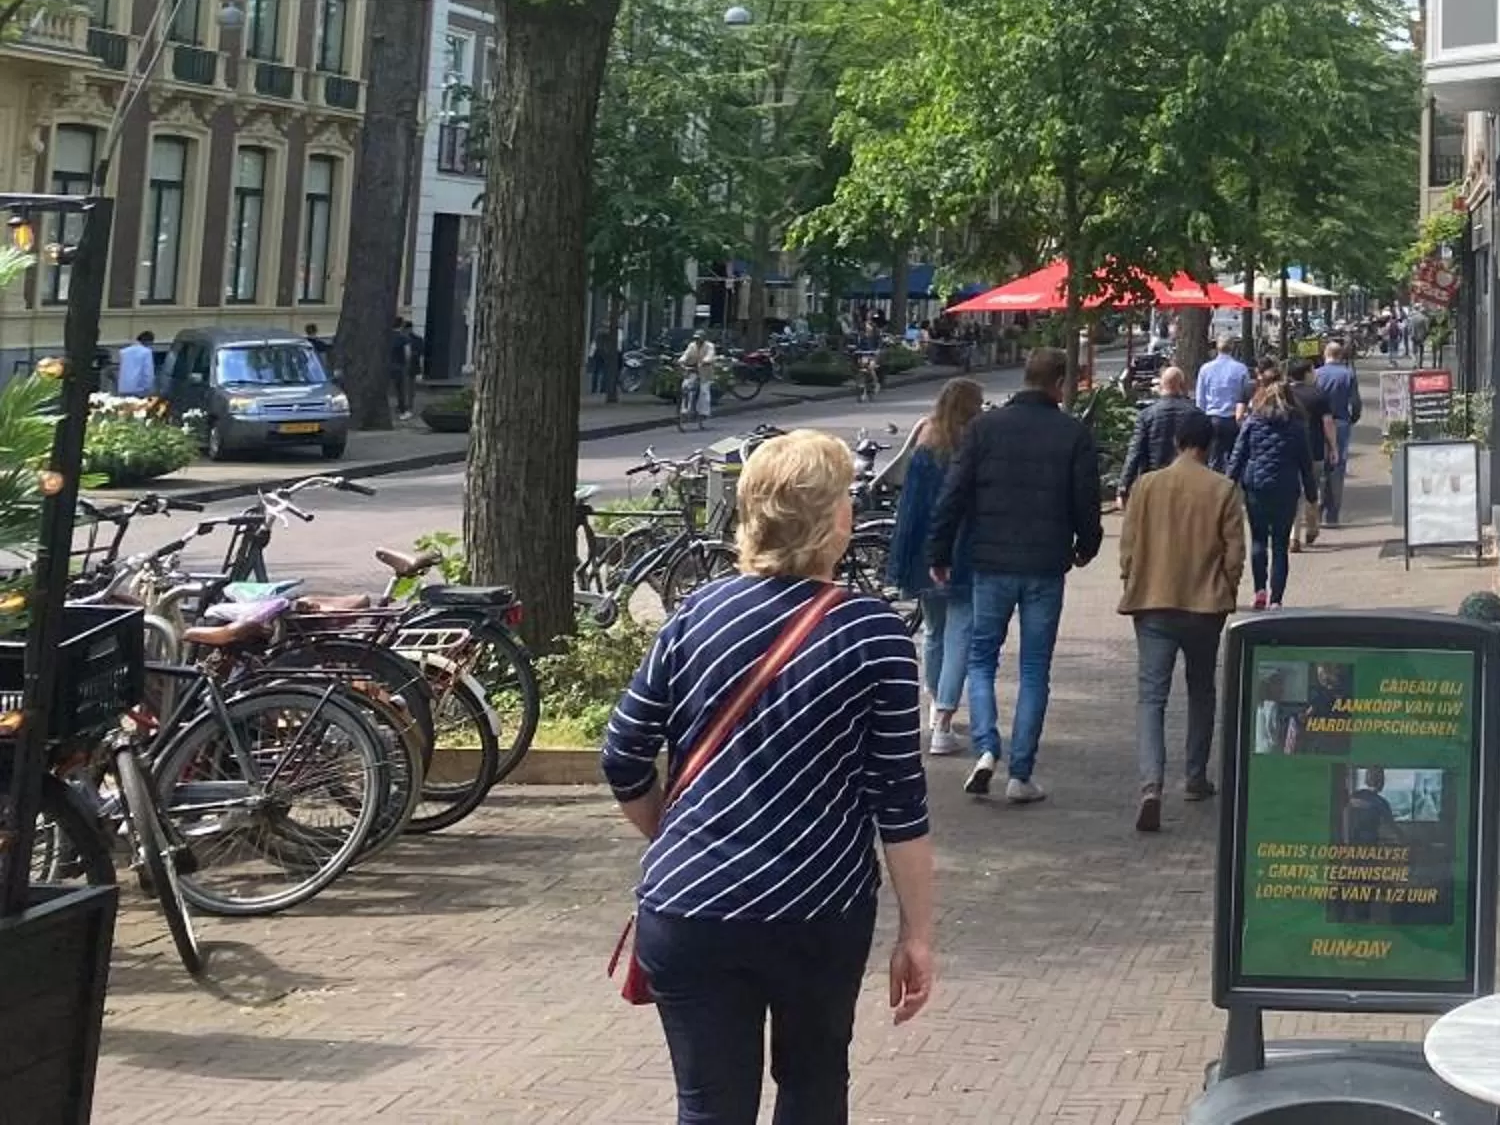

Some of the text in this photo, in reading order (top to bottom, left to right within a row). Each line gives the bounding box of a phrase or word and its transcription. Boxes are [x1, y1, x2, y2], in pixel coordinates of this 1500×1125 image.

[1380, 678, 1464, 695] CADEAU BIJ
[1332, 698, 1464, 716] AANKOOP VAN UW
[1257, 842, 1410, 861] GRATIS LOOPANALYSE
[1268, 864, 1317, 879] GRATIS
[1323, 865, 1409, 882] TECHNISCHE
[1340, 886, 1371, 901] VAN
[1407, 888, 1438, 904] UUR
